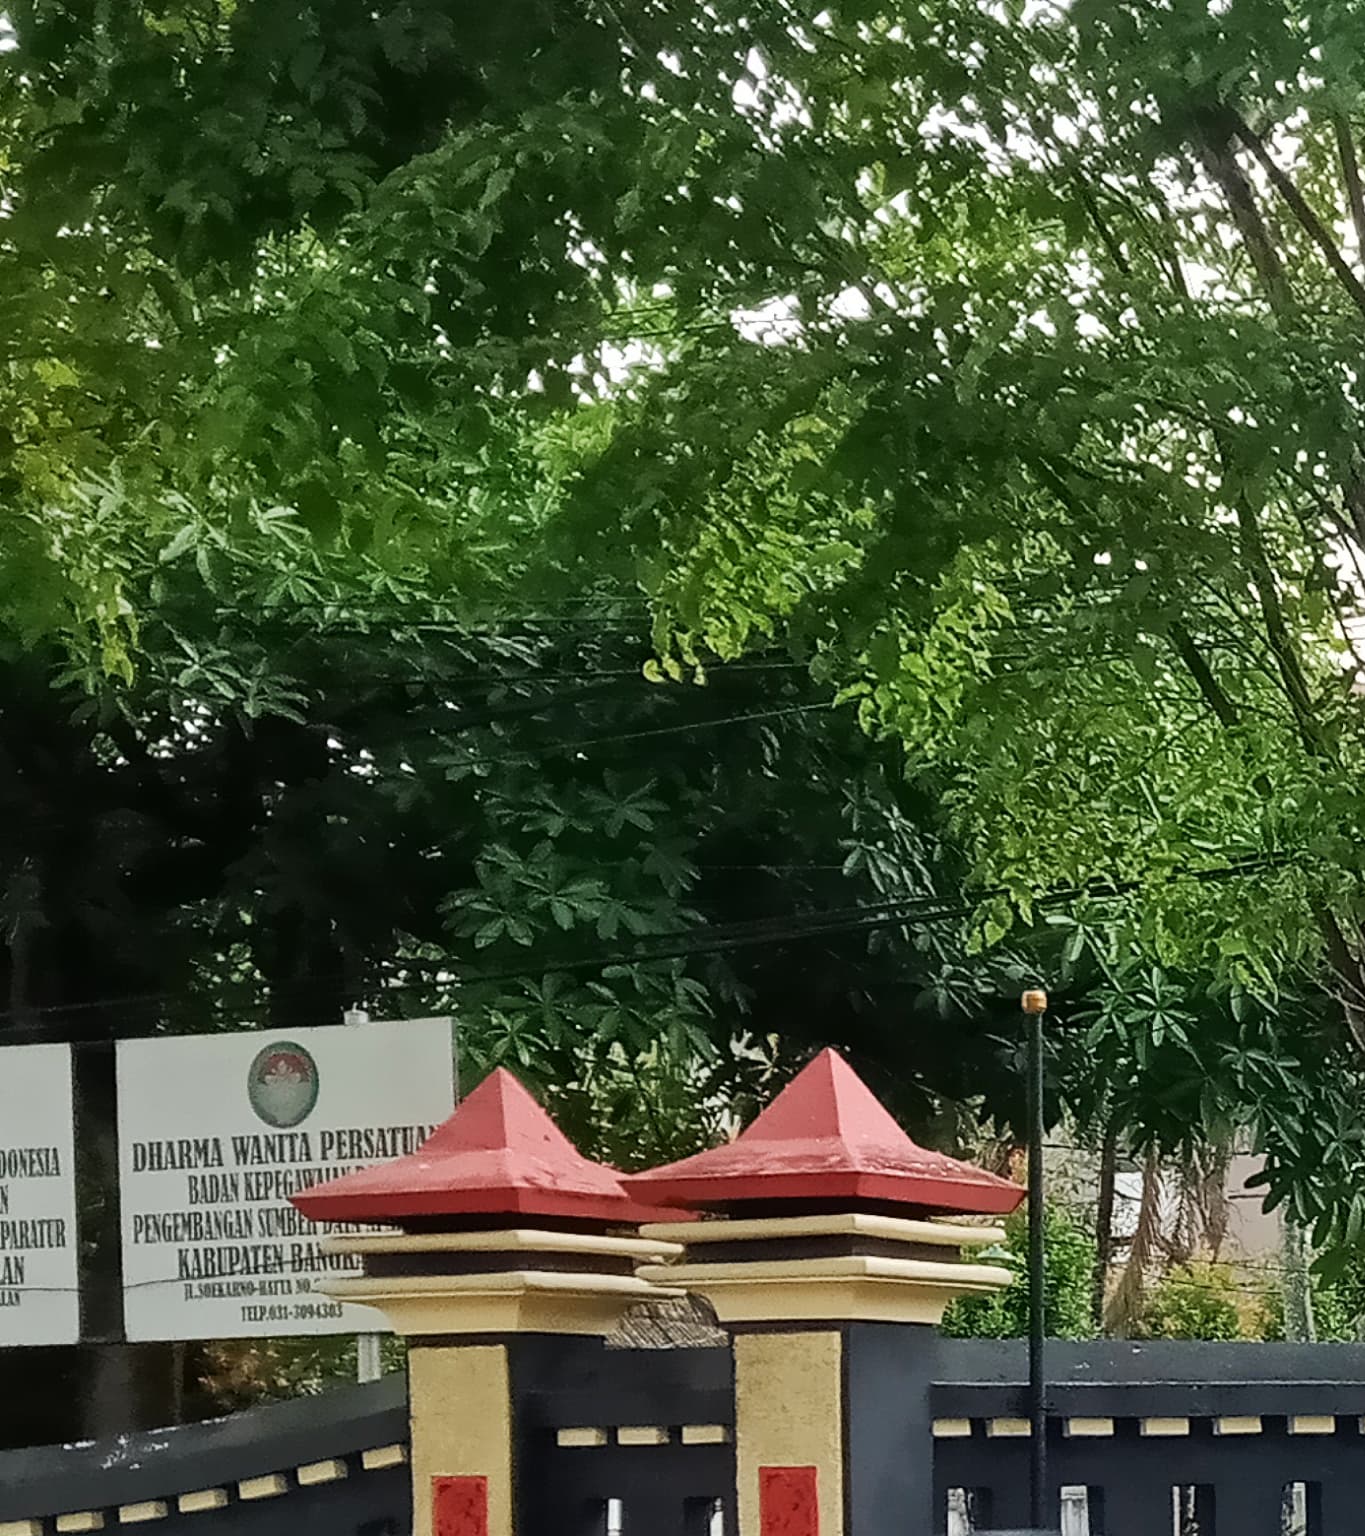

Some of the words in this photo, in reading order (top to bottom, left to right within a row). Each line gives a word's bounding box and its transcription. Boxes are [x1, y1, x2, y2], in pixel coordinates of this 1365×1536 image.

[132, 1137, 224, 1172] DHARMA
[231, 1132, 312, 1167] WANITA
[320, 1124, 440, 1161] PERSATUA
[188, 1170, 239, 1204] BADAN
[133, 1208, 253, 1244] PENGEMBANGAN
[178, 1244, 283, 1281] KABUPATEN
